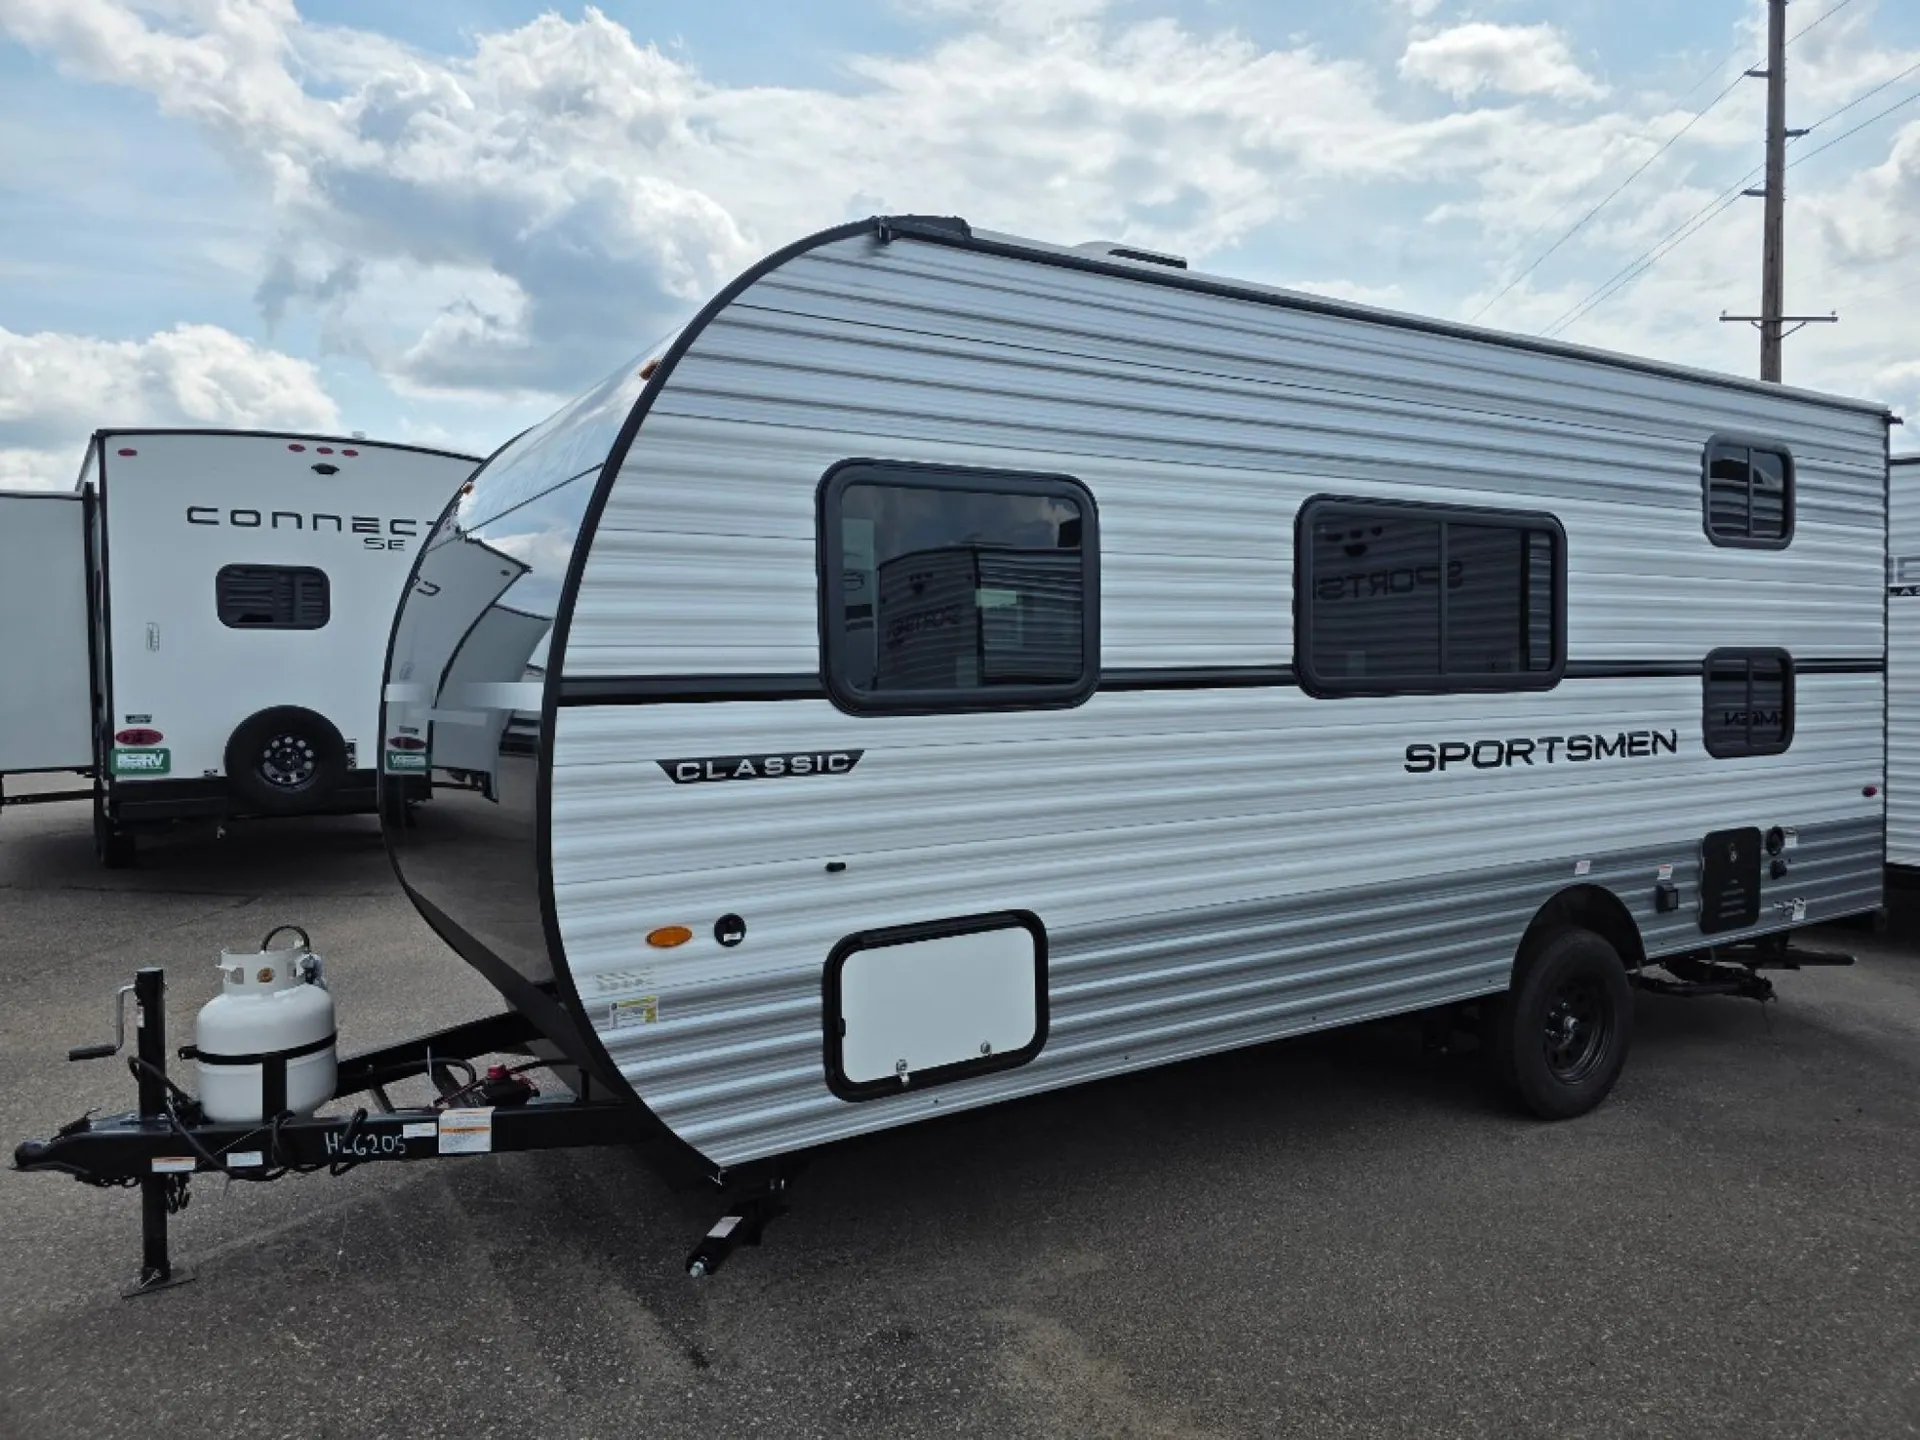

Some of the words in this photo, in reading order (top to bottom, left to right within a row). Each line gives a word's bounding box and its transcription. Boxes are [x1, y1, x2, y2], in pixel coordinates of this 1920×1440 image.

[363, 537, 405, 550] SE
[1404, 729, 1677, 773] SPORTSMEN
[676, 753, 850, 781] CLASSIC
